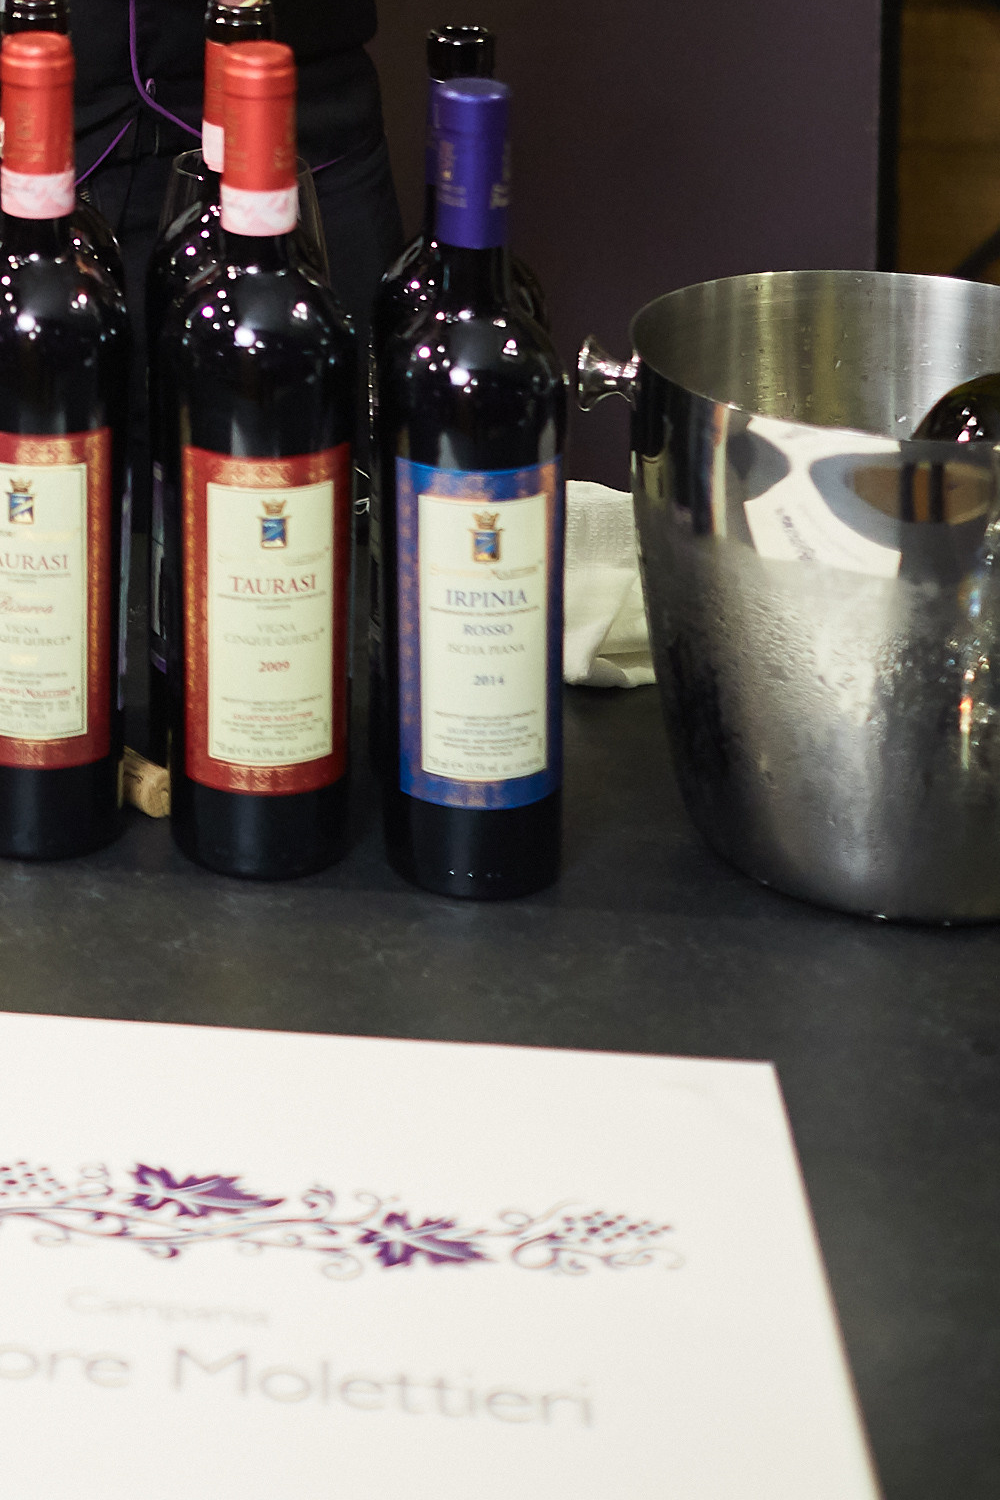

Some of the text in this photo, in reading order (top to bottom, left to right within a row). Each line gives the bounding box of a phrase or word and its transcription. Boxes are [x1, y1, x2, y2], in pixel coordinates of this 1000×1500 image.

[228, 573, 317, 596] TAURASI
[446, 588, 528, 608] IRPINIA
[463, 623, 514, 636] ROSSO
[173, 1347, 596, 1428] Molettieri
